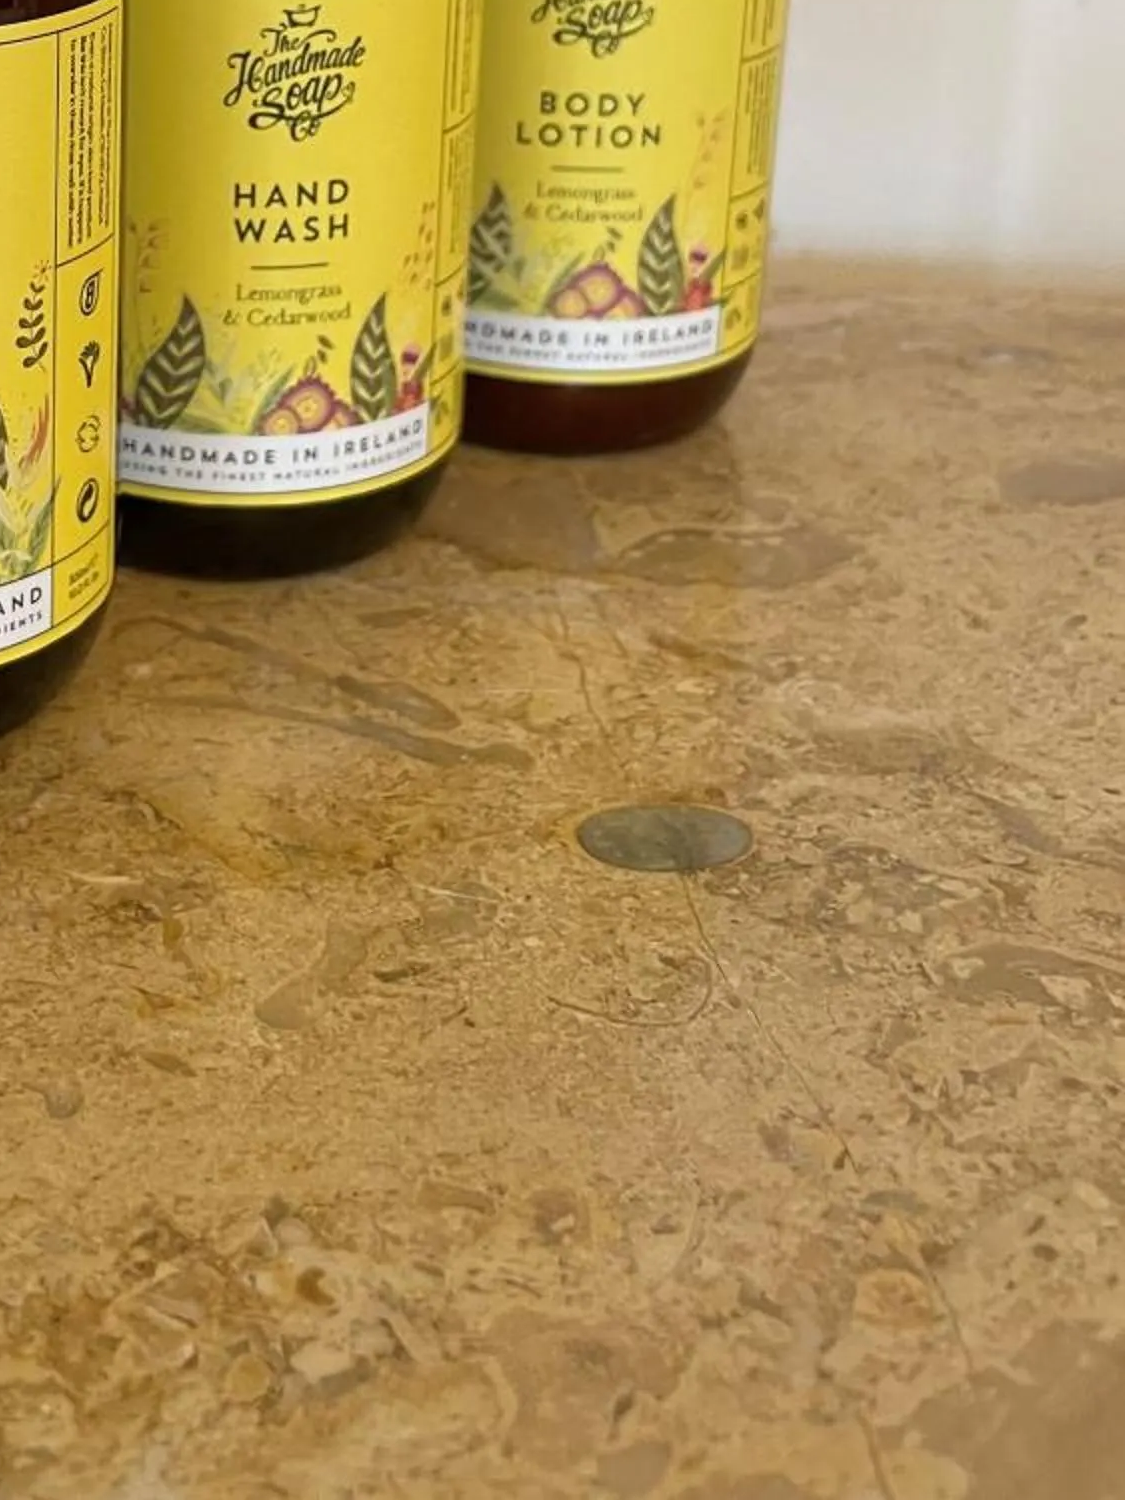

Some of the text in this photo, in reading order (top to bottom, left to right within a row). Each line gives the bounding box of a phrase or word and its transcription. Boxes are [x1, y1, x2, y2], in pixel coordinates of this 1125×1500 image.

[552, 0, 653, 46] Soap
[260, 22, 337, 57] The
[223, 36, 366, 106] Handmade
[248, 73, 354, 130] Soap
[540, 91, 645, 117] BODY
[286, 109, 321, 141] Co
[516, 121, 661, 149] LOTION
[234, 178, 349, 208] HAND
[536, 179, 636, 204] Lemongrass
[545, 203, 643, 222] Cedarwood
[234, 213, 349, 243] WASH
[236, 283, 342, 305] Lemongrass
[223, 301, 351, 326] & Cedarwood
[584, 332, 608, 346] IN
[623, 318, 712, 347] IRELAND
[122, 419, 422, 465] HANDMADE IN IRELAND
